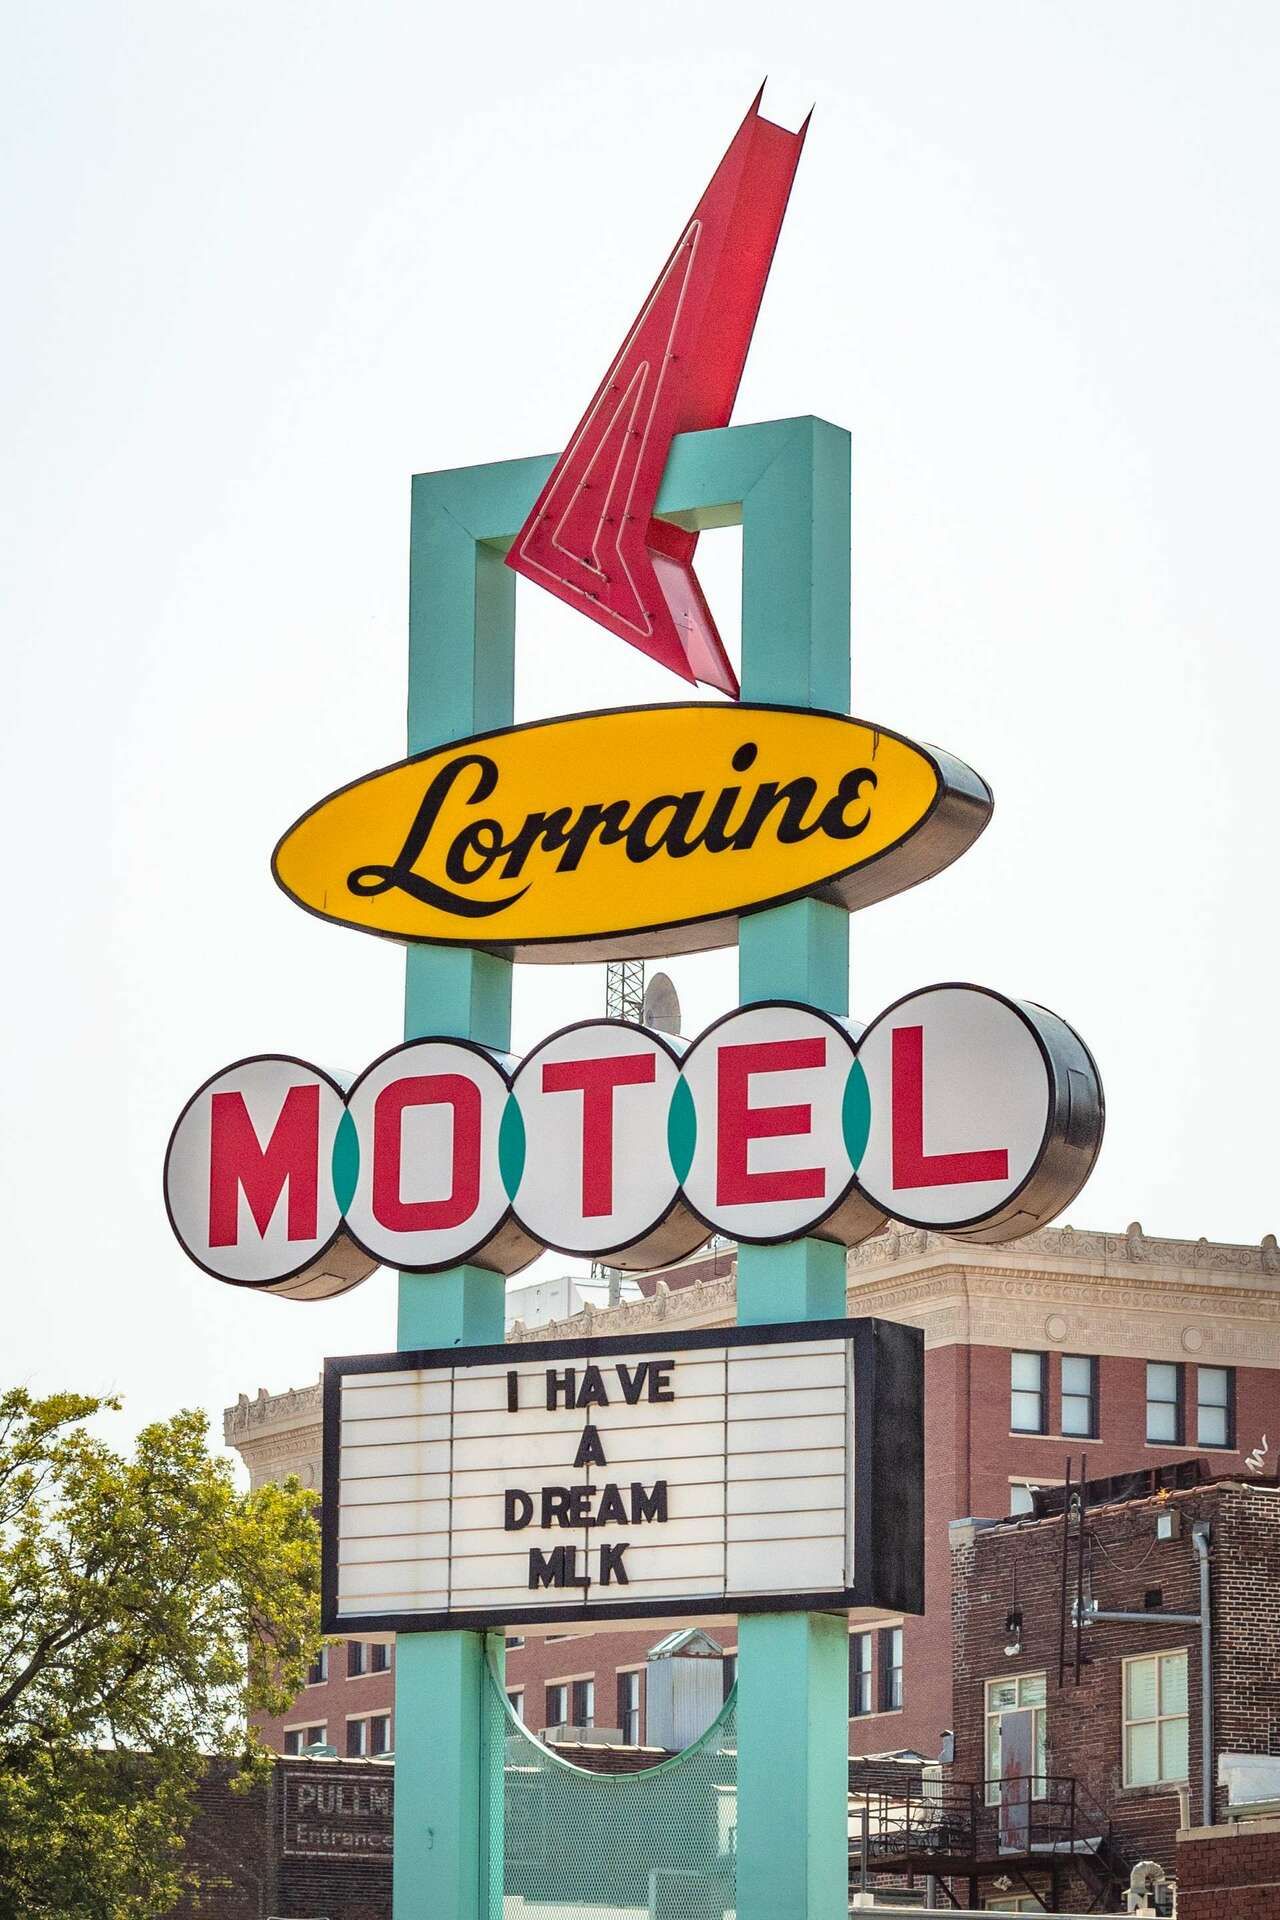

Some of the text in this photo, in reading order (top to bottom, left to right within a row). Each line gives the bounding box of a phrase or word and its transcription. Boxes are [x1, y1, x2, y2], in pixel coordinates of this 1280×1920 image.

[347, 741, 878, 918] Lorraine
[208, 1025, 1009, 1248] MOTEL
[507, 1360, 675, 1413] I HAVE
[573, 1425, 607, 1467] A
[504, 1480, 668, 1531] DREAM
[528, 1543, 630, 1589] MLK
[298, 1785, 394, 1816] PULLM
